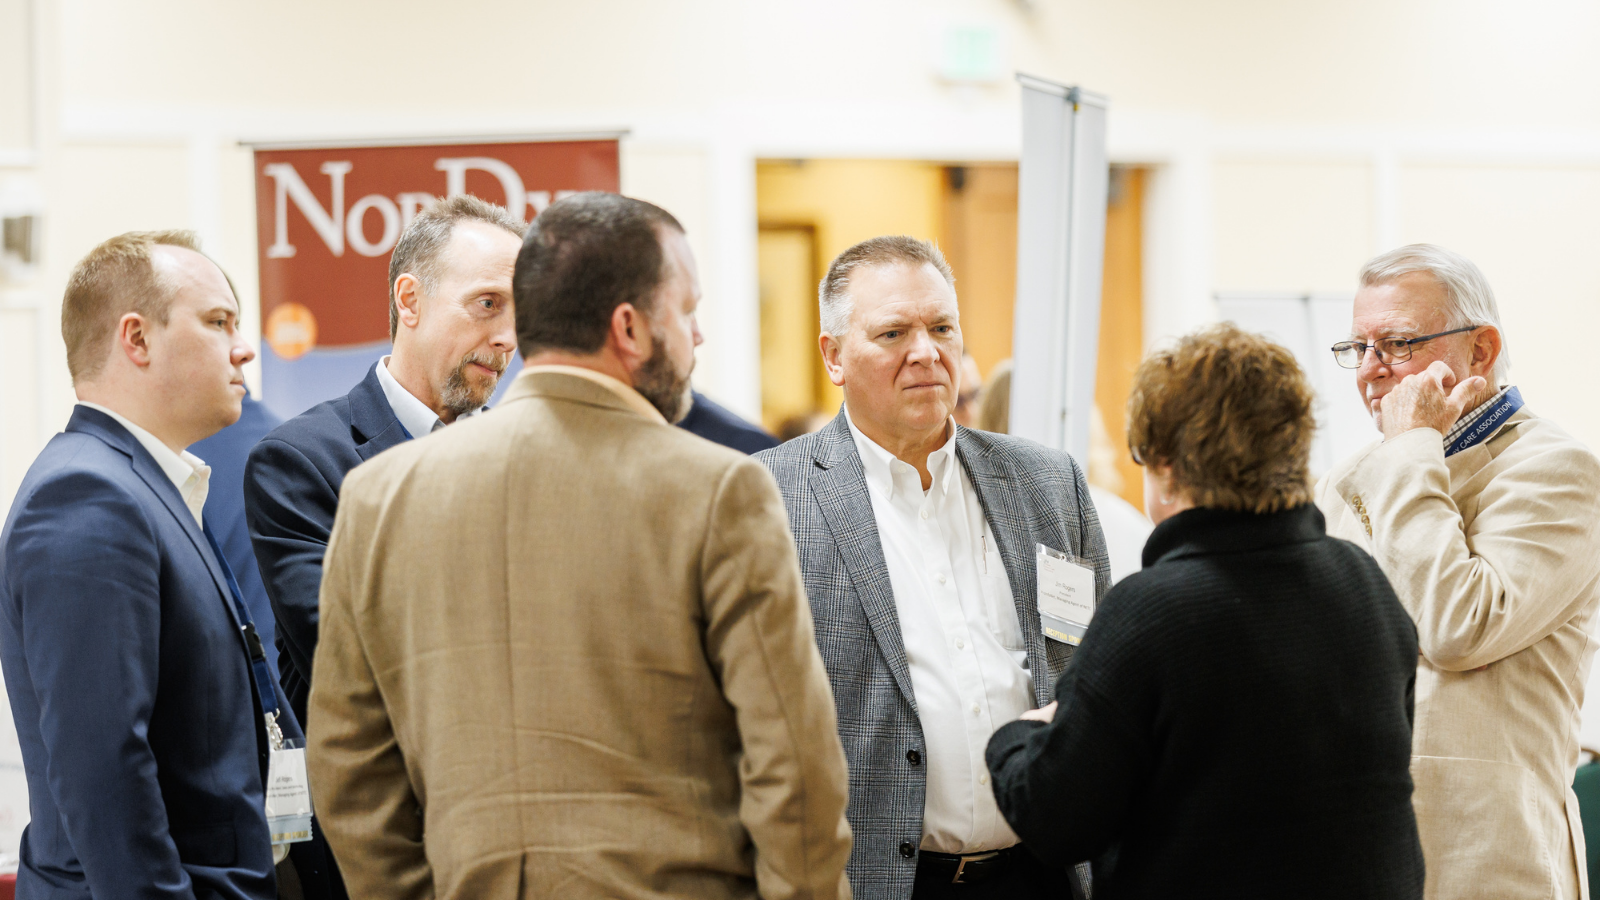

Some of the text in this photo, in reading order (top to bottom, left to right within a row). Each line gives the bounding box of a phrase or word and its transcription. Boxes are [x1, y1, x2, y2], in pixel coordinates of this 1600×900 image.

[1460, 432, 1477, 448] CARE
[1476, 401, 1512, 435] ASSOCIATION
[1045, 627, 1067, 640] RECEPTION
